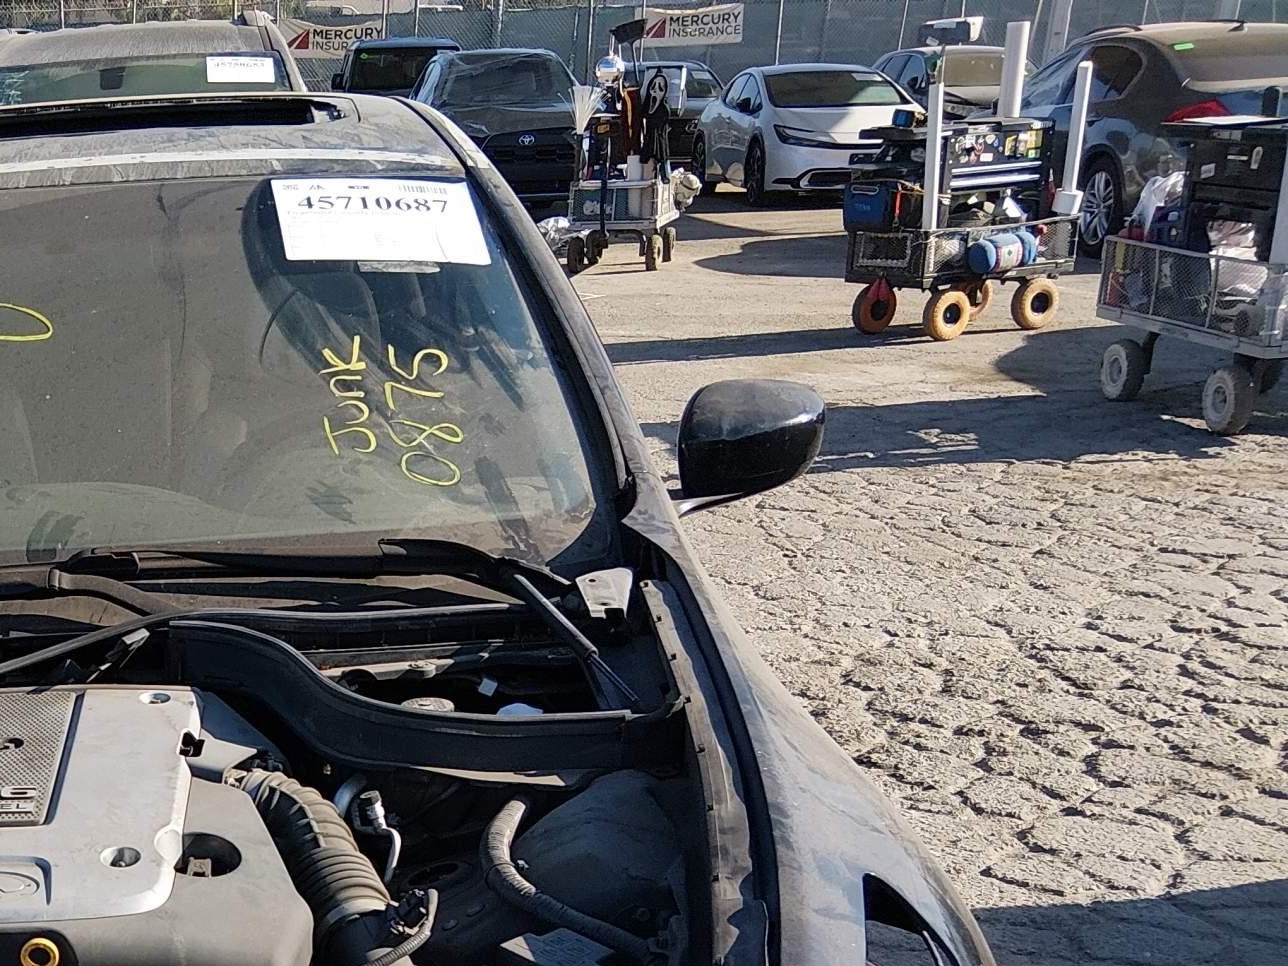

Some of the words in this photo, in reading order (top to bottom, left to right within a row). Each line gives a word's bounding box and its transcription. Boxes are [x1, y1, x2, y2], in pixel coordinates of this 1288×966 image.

[669, 11, 741, 27] MERCURY
[312, 27, 383, 40] MERCURY
[297, 195, 448, 213] 45710687
[383, 343, 464, 487] 0875
